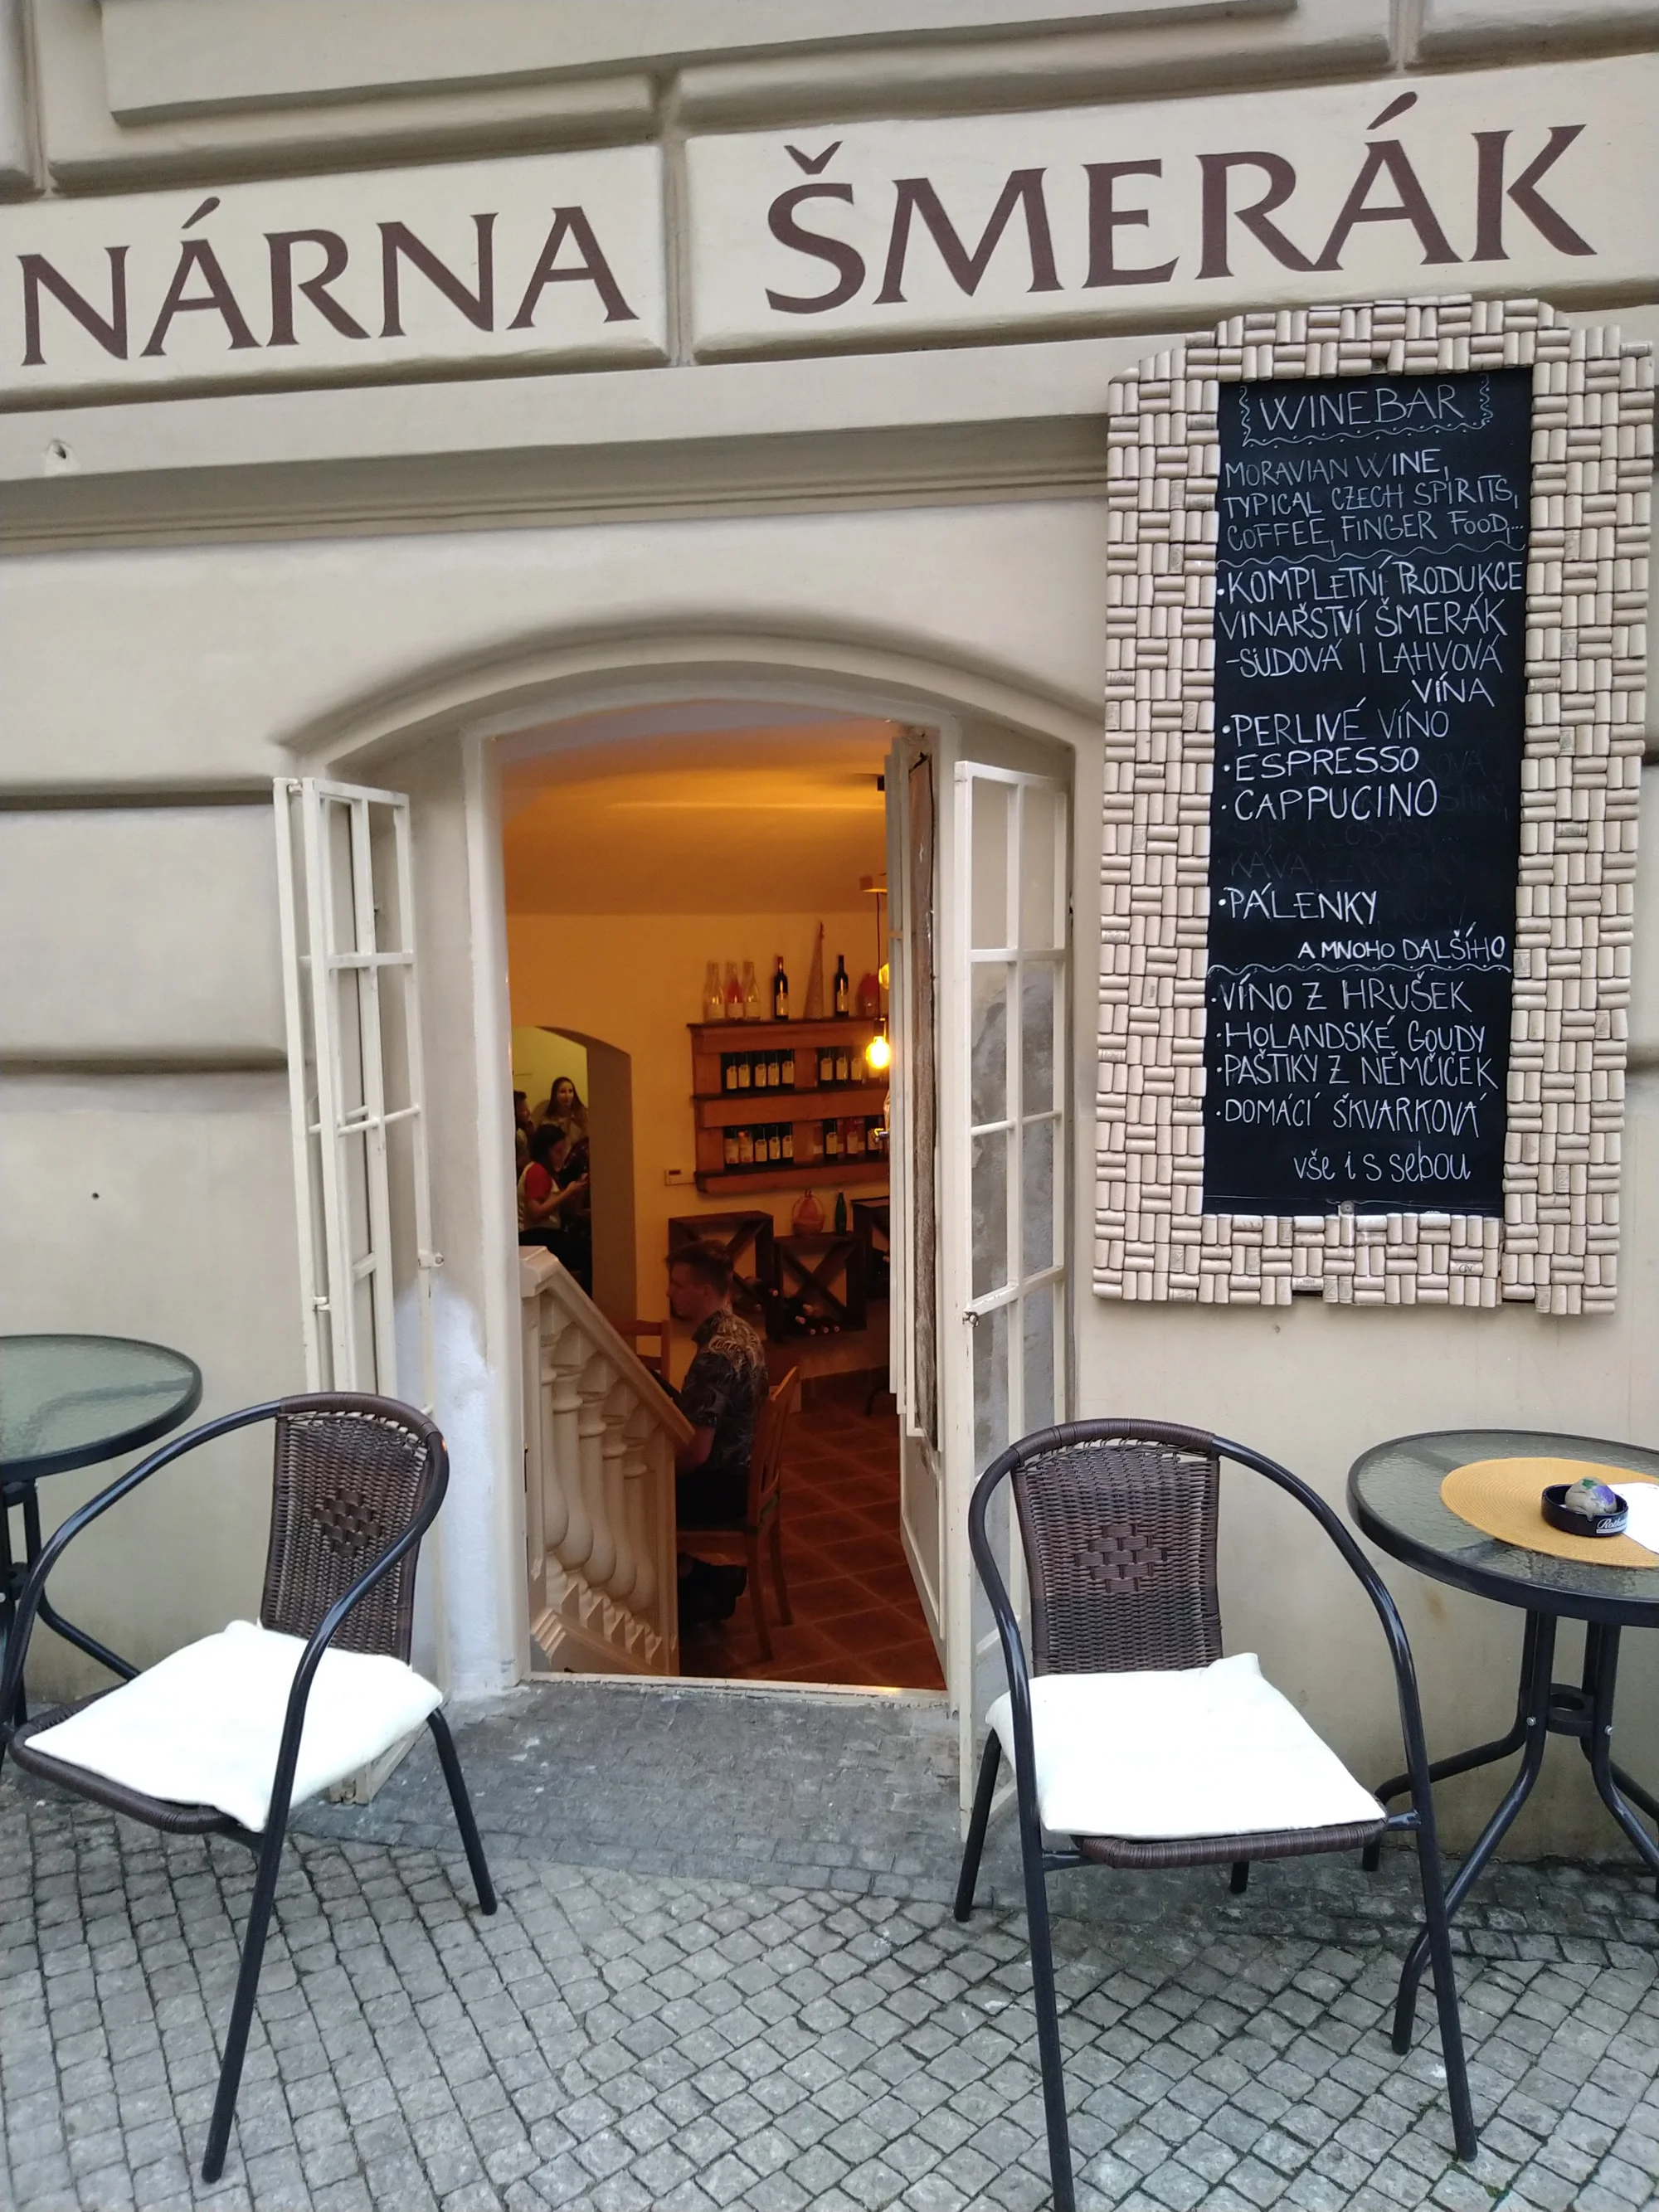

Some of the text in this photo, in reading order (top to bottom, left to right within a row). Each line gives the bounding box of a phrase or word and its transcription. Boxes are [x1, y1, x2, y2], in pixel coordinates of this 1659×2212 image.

[17, 92, 1597, 367] NÁRNA ŠMERÁK
[1224, 458, 1349, 489] MORAVIAN
[1224, 492, 1322, 519] TYPICAL
[1331, 484, 1404, 510] CZECH
[1340, 511, 1438, 542] FINGER
[1392, 562, 1523, 596] PRODUKCE
[1219, 591, 1508, 640] VINAŘSTVÍ ŠMERÁK
[1378, 634, 1504, 676] LAHVOVÁ
[1411, 672, 1495, 707] VÍNA
[1230, 696, 1449, 747] PERLIVÉ VÍNO
[1236, 746, 1420, 782] ESPRESSO
[1234, 778, 1438, 820] CAPPUCINO
[1223, 882, 1377, 925] PÁLENKY
[1403, 921, 1506, 961] DALŠÍHO
[1219, 970, 1472, 1013] VÍNO Z HRUŠEK
[1224, 1014, 1486, 1054] HOLANDSKÉ GOUDY
[1224, 1048, 1498, 1089] PAŠTIKY Z NĚMČIČEK
[1224, 1091, 1488, 1138] DOMÁCÍ ŠKVARKOVÁ
[1293, 1149, 1335, 1181] vše
[1389, 1140, 1471, 1183] sebou
